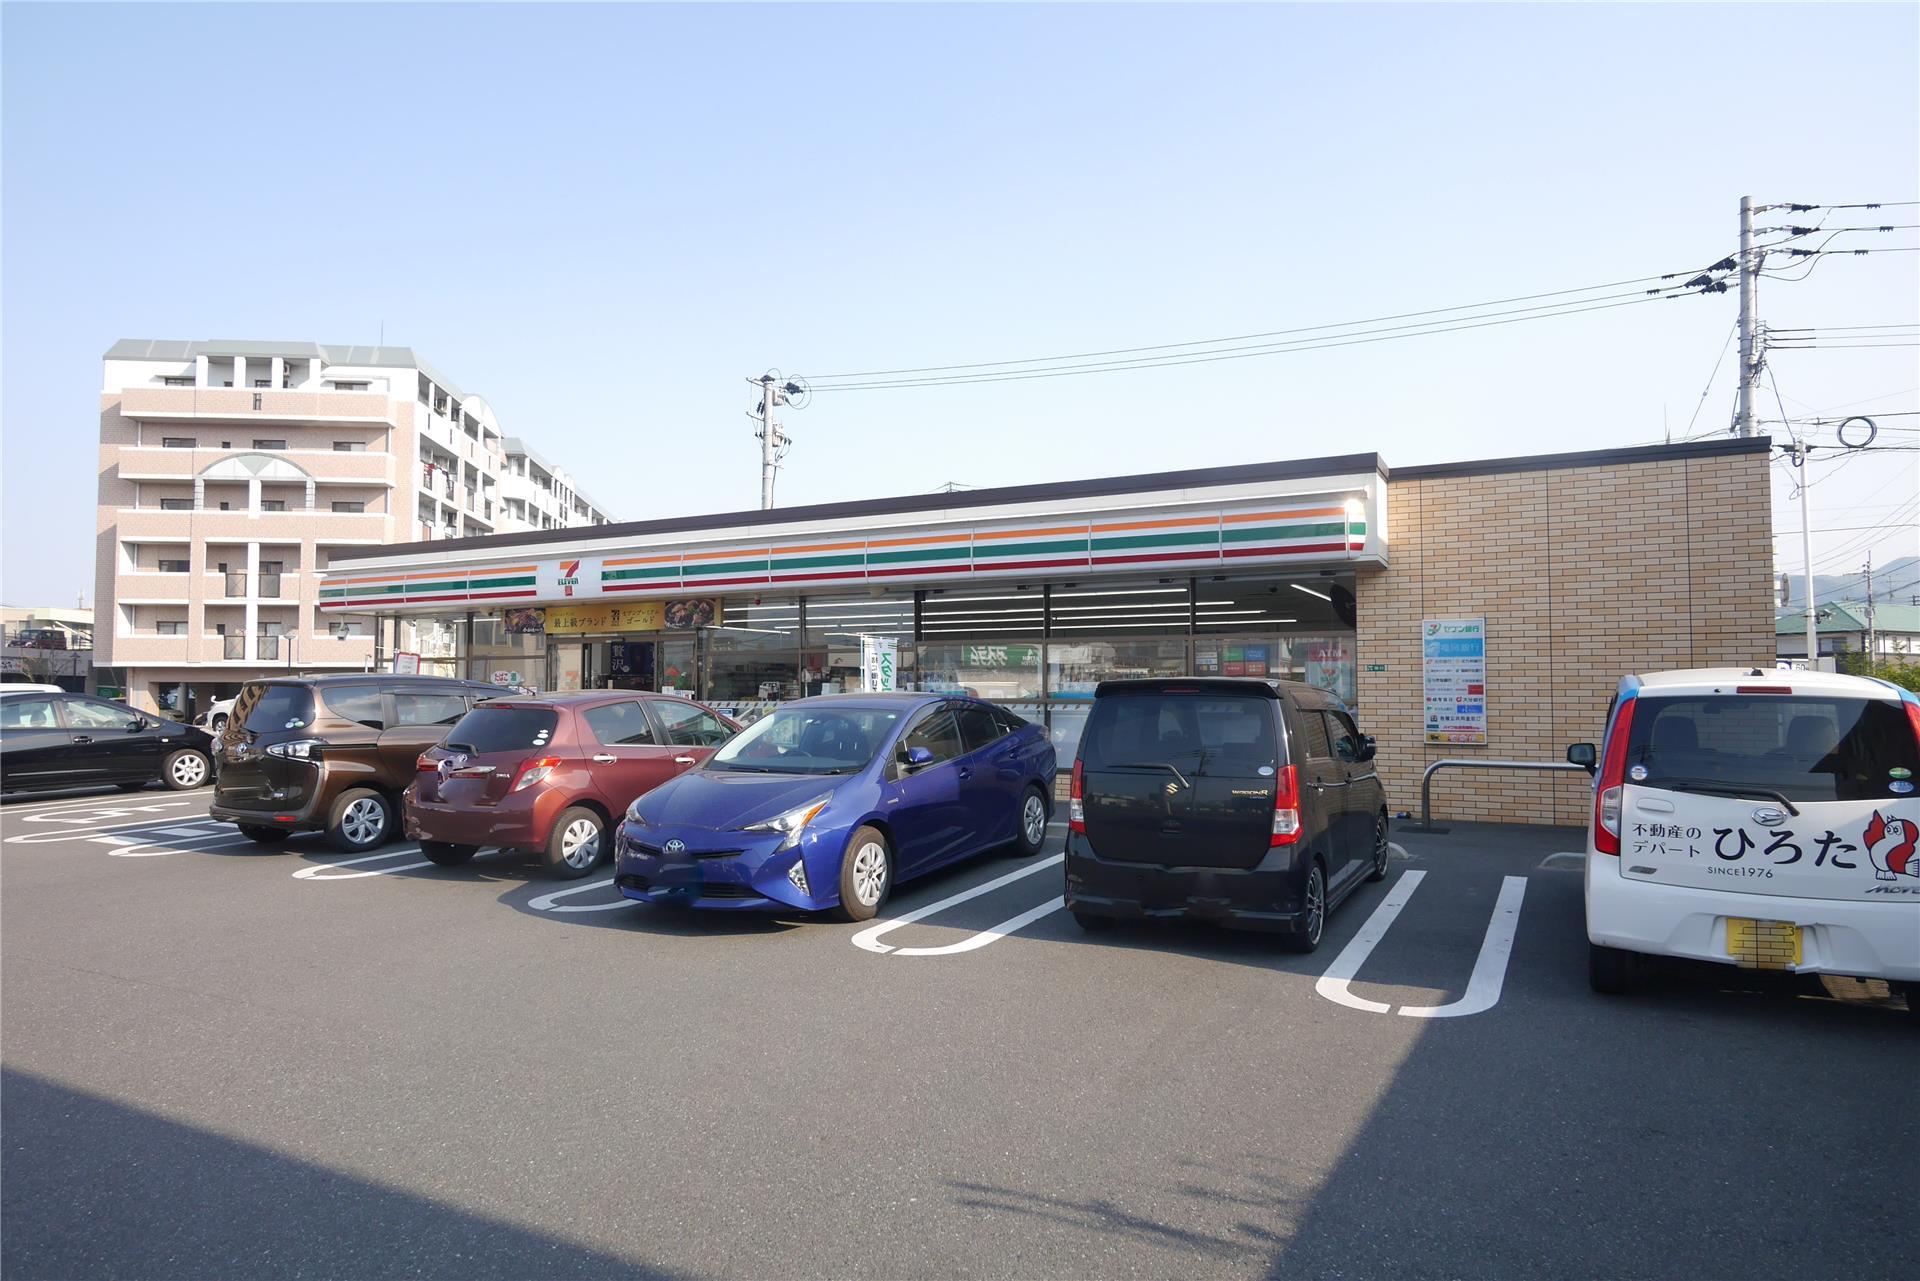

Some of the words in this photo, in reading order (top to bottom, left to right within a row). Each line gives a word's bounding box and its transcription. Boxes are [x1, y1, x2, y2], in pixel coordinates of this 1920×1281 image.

[1318, 649, 1342, 657] ATM
[1632, 823, 1701, 840] 不動産の
[1632, 841, 1700, 858] デパート
[1713, 827, 1857, 869] ひろた
